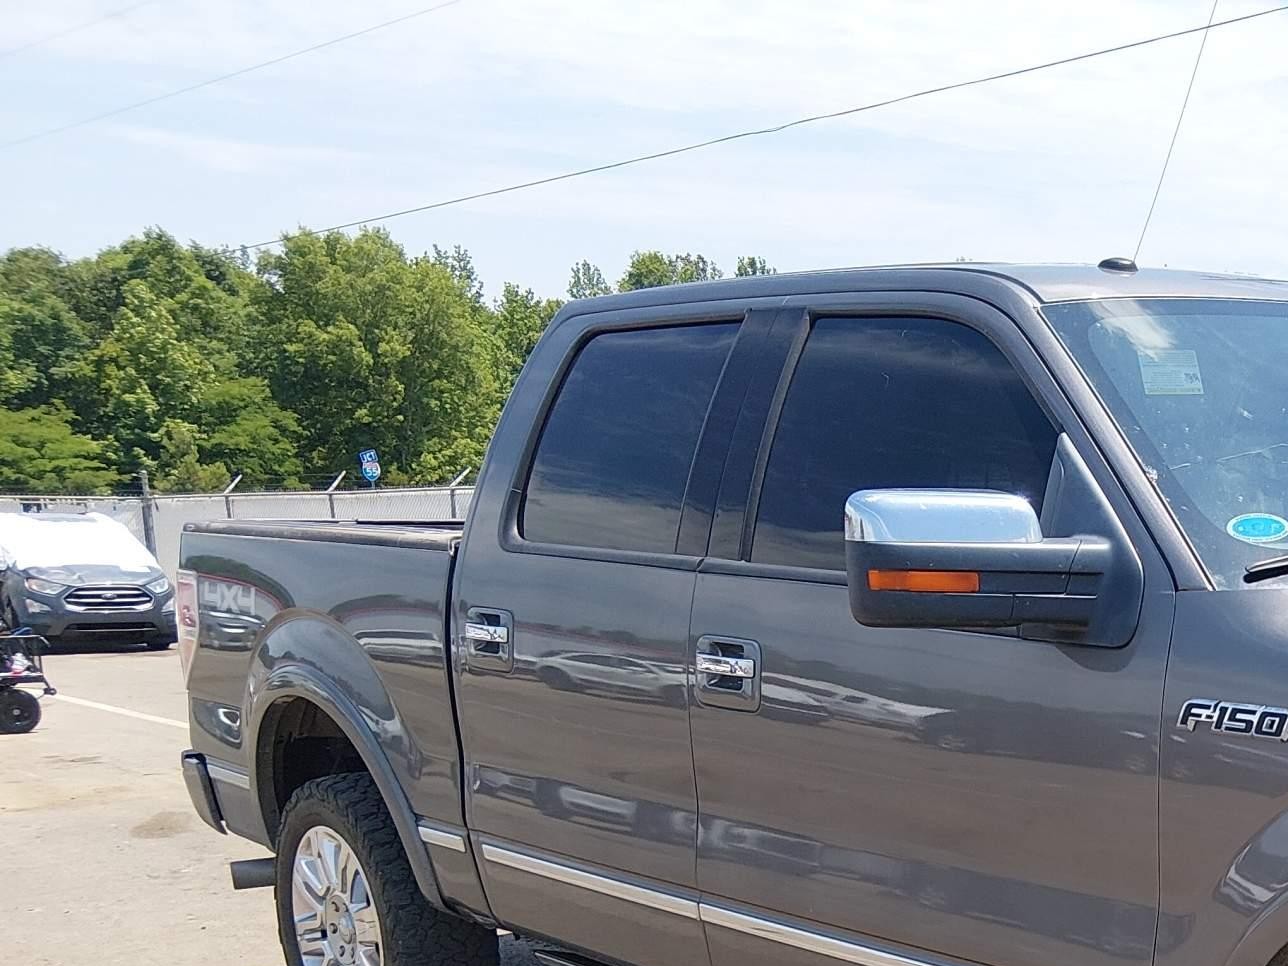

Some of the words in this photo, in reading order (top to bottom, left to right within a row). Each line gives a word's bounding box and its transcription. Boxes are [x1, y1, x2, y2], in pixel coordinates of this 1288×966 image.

[362, 452, 375, 463] JCT
[366, 467, 378, 476] 55
[203, 581, 257, 616] 4X4
